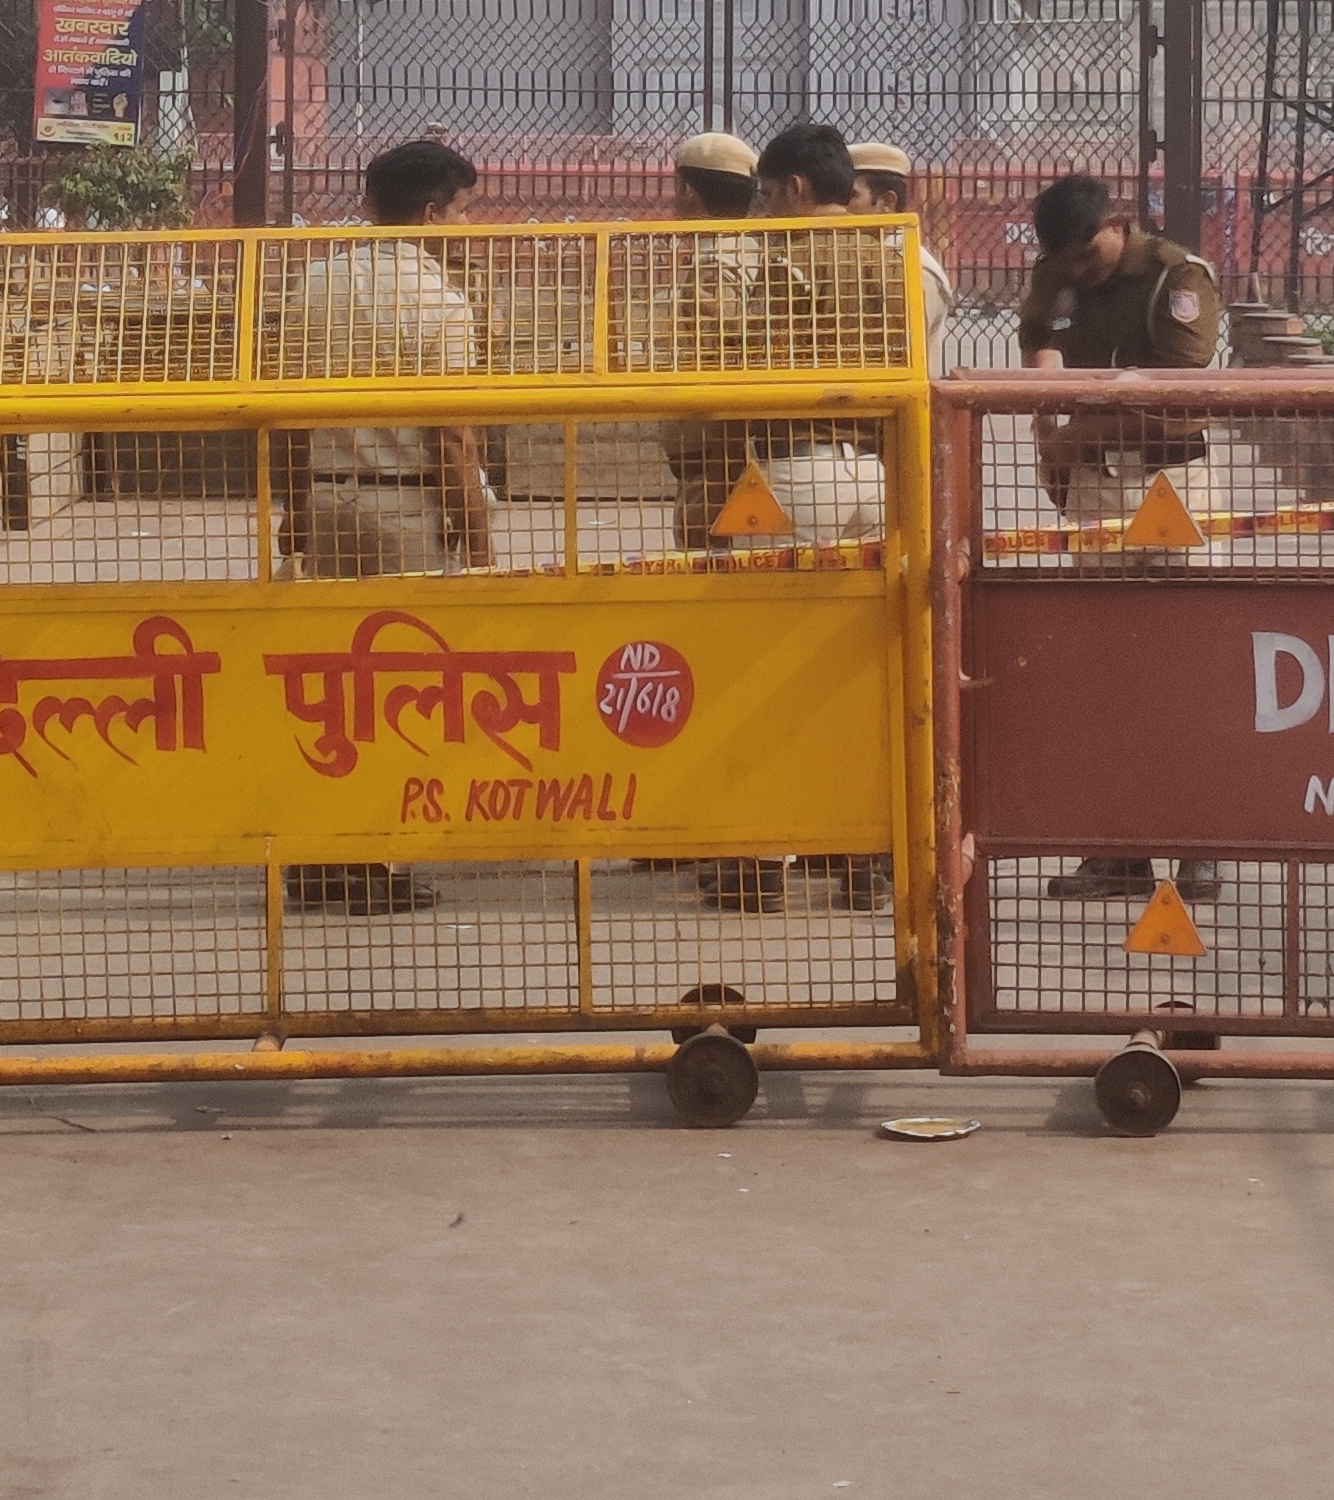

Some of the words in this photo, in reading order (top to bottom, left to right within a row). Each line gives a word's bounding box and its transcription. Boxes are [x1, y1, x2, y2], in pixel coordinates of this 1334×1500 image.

[113, 132, 133, 142] 112
[620, 644, 661, 670] ND
[263, 610, 576, 778] पुलिस
[464, 772, 637, 823] KOTWALI
